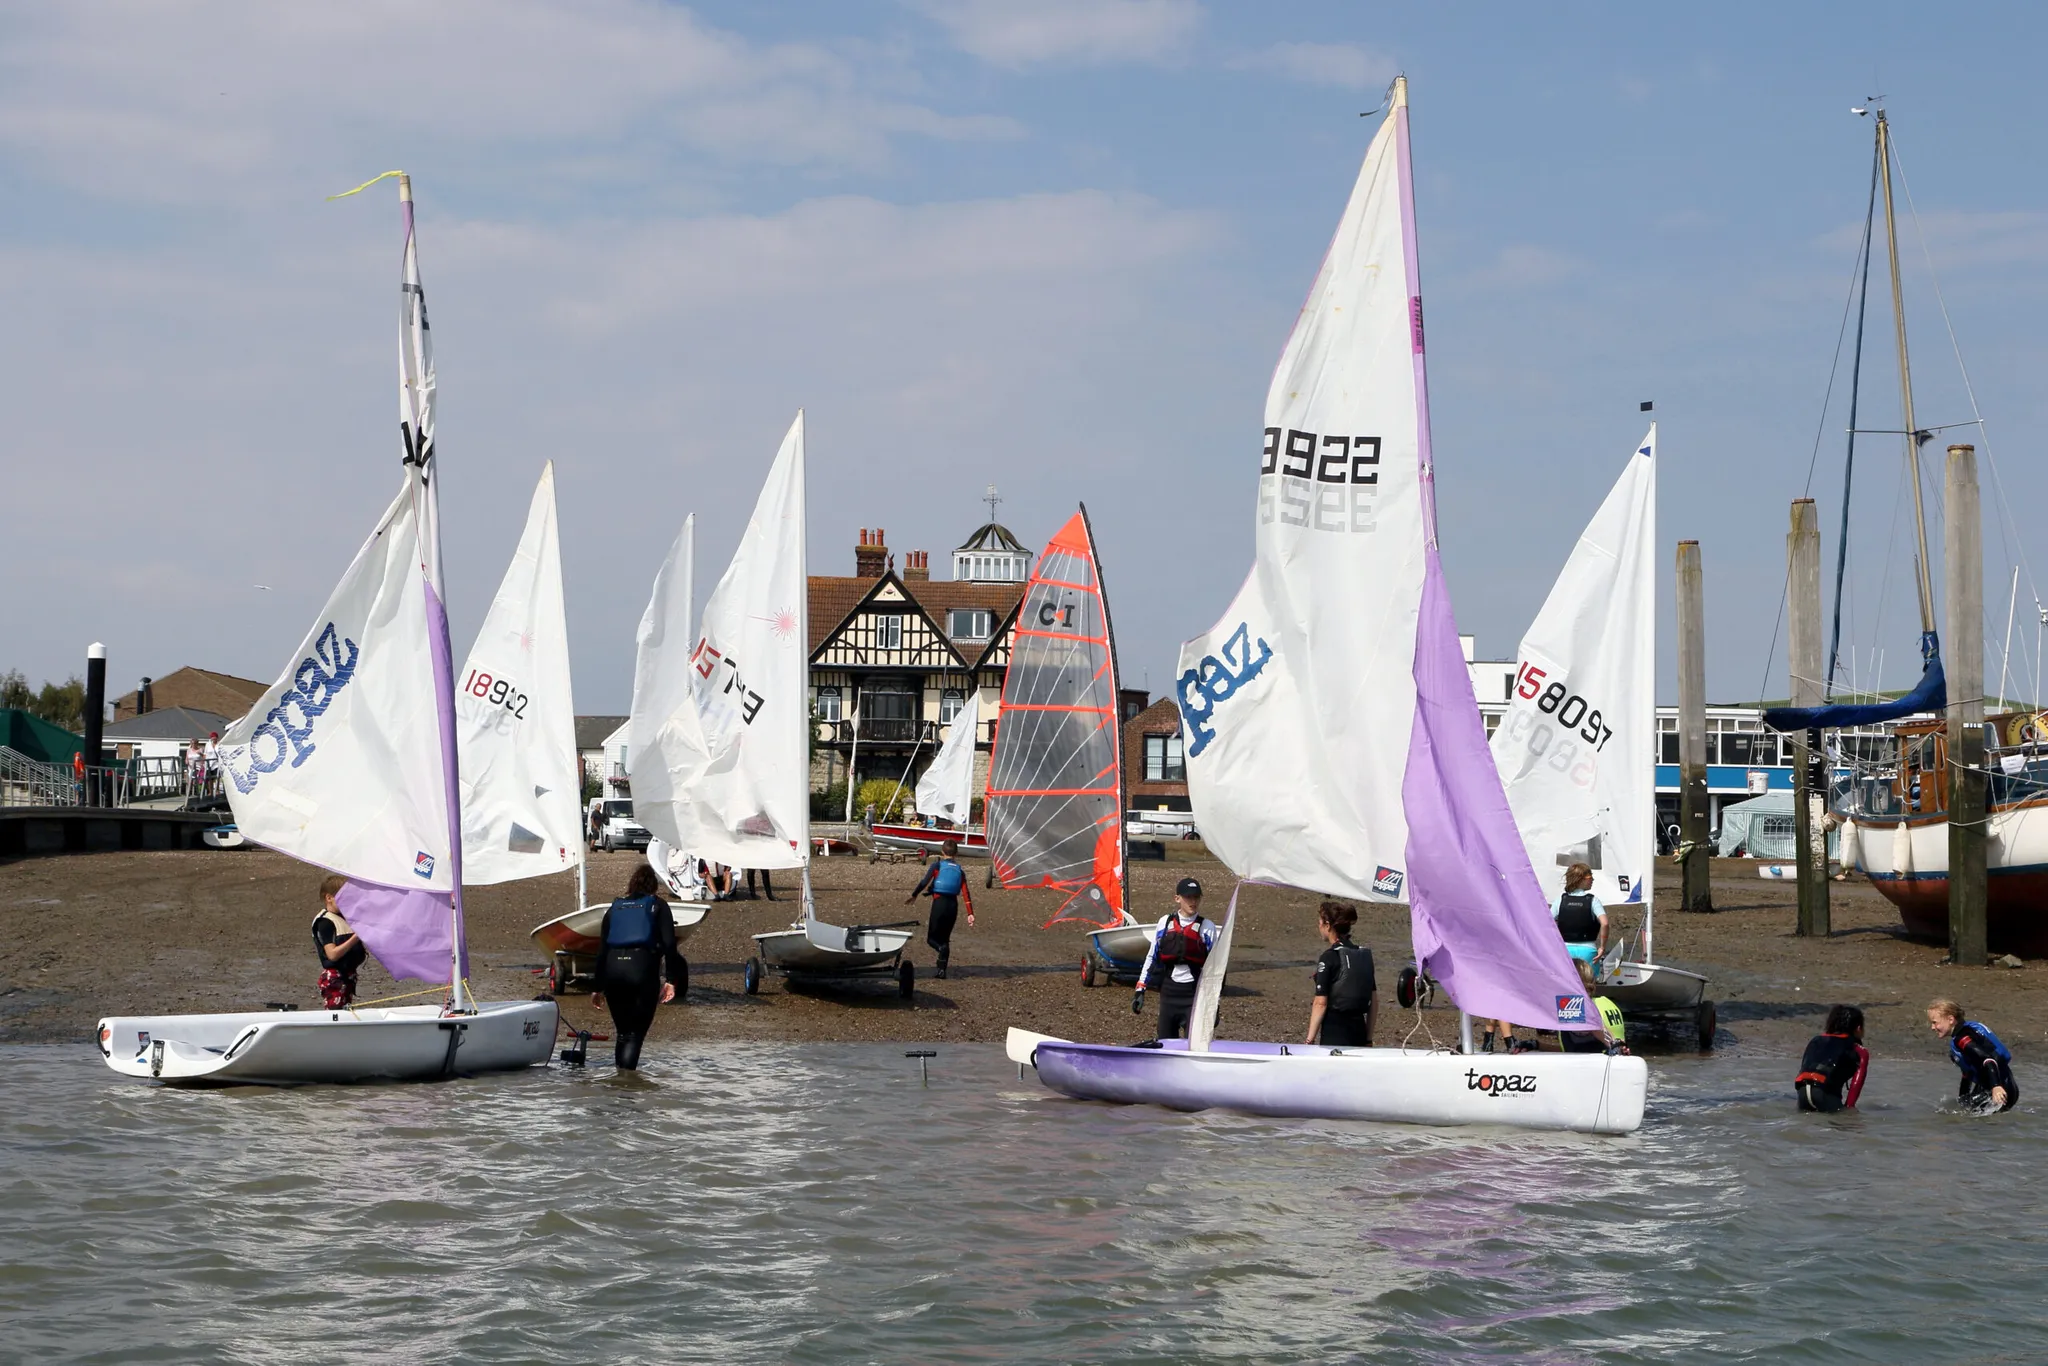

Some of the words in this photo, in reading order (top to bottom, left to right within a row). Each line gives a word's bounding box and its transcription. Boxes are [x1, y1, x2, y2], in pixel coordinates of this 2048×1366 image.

[1513, 661, 1613, 753] 158097
[1373, 879, 1398, 892] topper
[1558, 1009, 1582, 1019] topper
[1464, 1067, 1538, 1098] topaz
